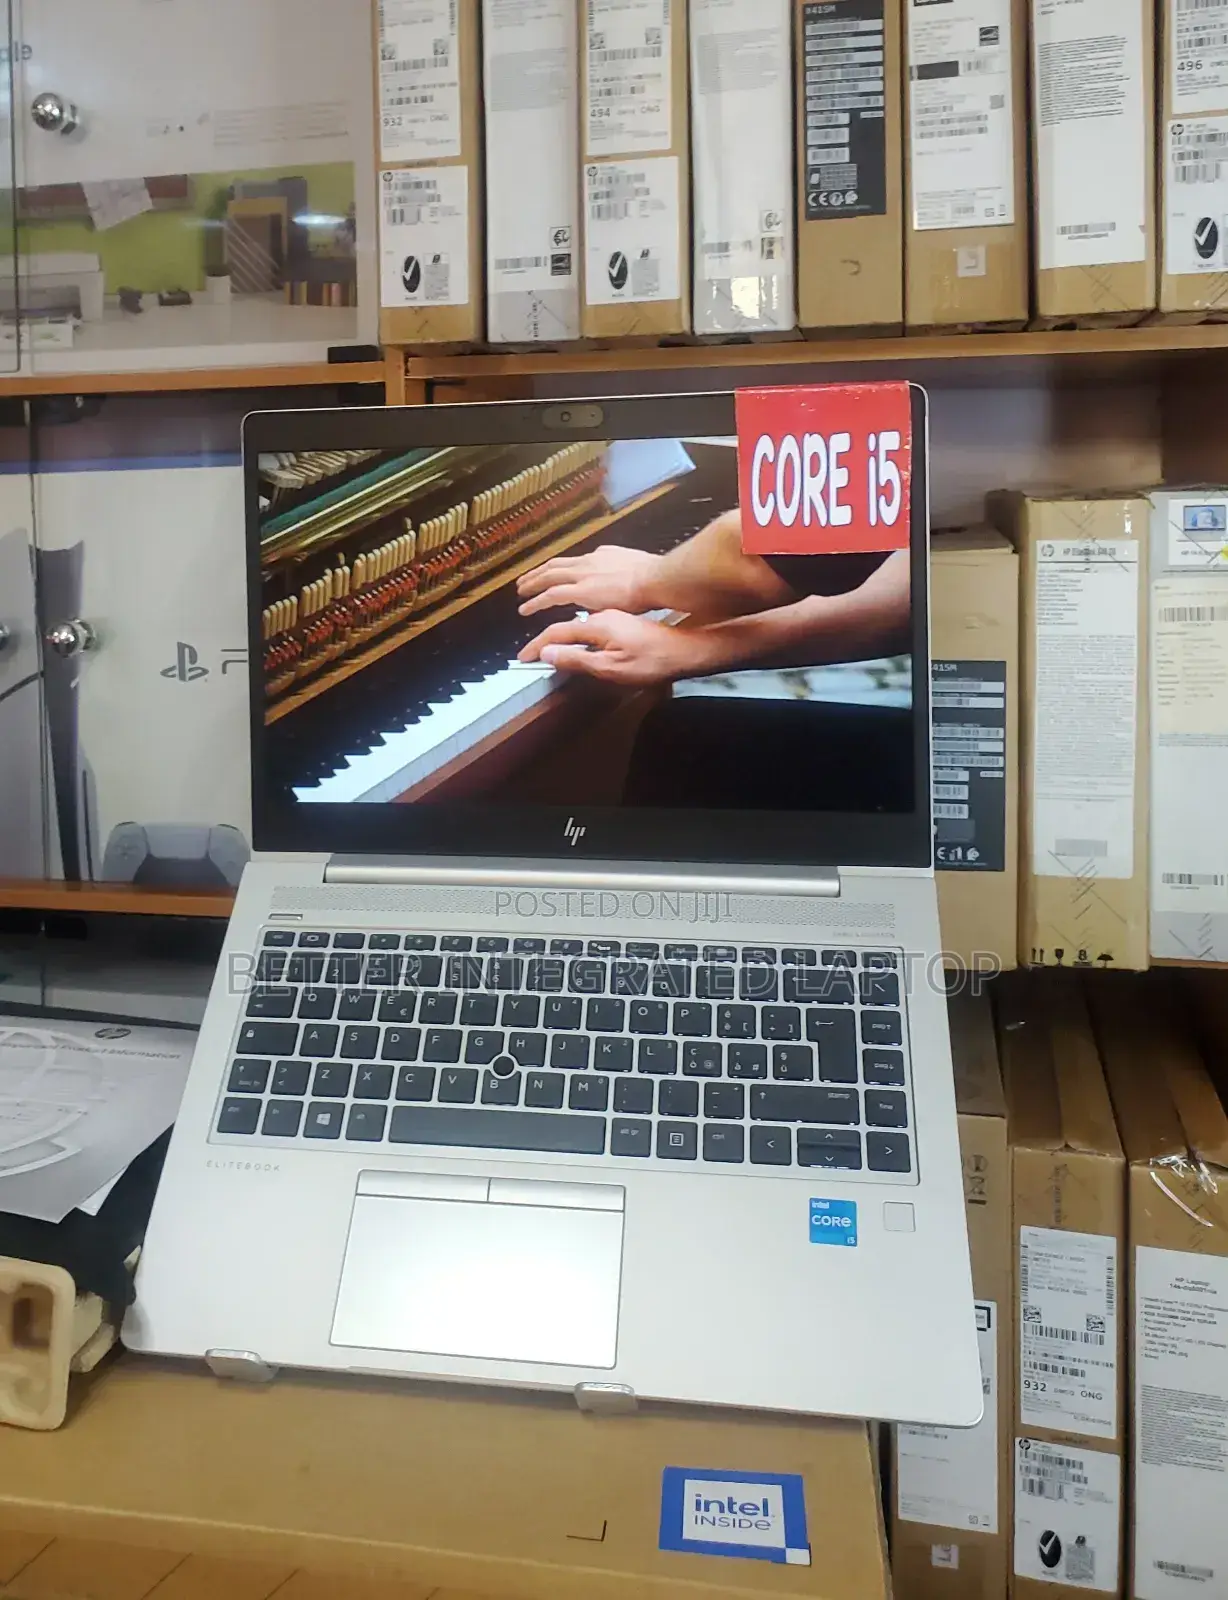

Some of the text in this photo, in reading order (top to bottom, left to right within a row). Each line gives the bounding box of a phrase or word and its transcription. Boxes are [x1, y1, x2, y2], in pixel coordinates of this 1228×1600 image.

[1177, 60, 1203, 71] 496
[590, 107, 611, 117] 494
[383, 115, 402, 127] 932
[752, 431, 901, 527] CORE i5
[564, 817, 587, 846] hp
[306, 992, 317, 1002] Q
[348, 994, 362, 1003] W
[385, 994, 396, 1005] E
[427, 998, 436, 1006] R
[468, 999, 476, 1008] T
[511, 1001, 519, 1009] Y
[552, 1003, 561, 1012] U
[638, 1007, 648, 1016] O
[681, 1009, 689, 1017] P
[310, 1031, 318, 1039] A
[350, 1032, 358, 1041] S
[391, 1033, 400, 1042] D
[432, 1035, 440, 1044] F
[474, 1037, 483, 1046] G
[516, 1039, 525, 1047] H
[559, 1041, 566, 1050] J
[603, 1044, 611, 1053] K
[647, 1046, 654, 1055] L
[321, 1069, 330, 1079] Z
[363, 1072, 372, 1080] X
[405, 1073, 414, 1082] C
[448, 1075, 457, 1084] V
[490, 1078, 500, 1089] B
[534, 1080, 543, 1089] N
[578, 1082, 588, 1091] M
[206, 1160, 281, 1172] ELITEBOOK
[1023, 1379, 1047, 1392] 932
[1080, 1390, 1103, 1401] ONG
[695, 1493, 770, 1517] intel
